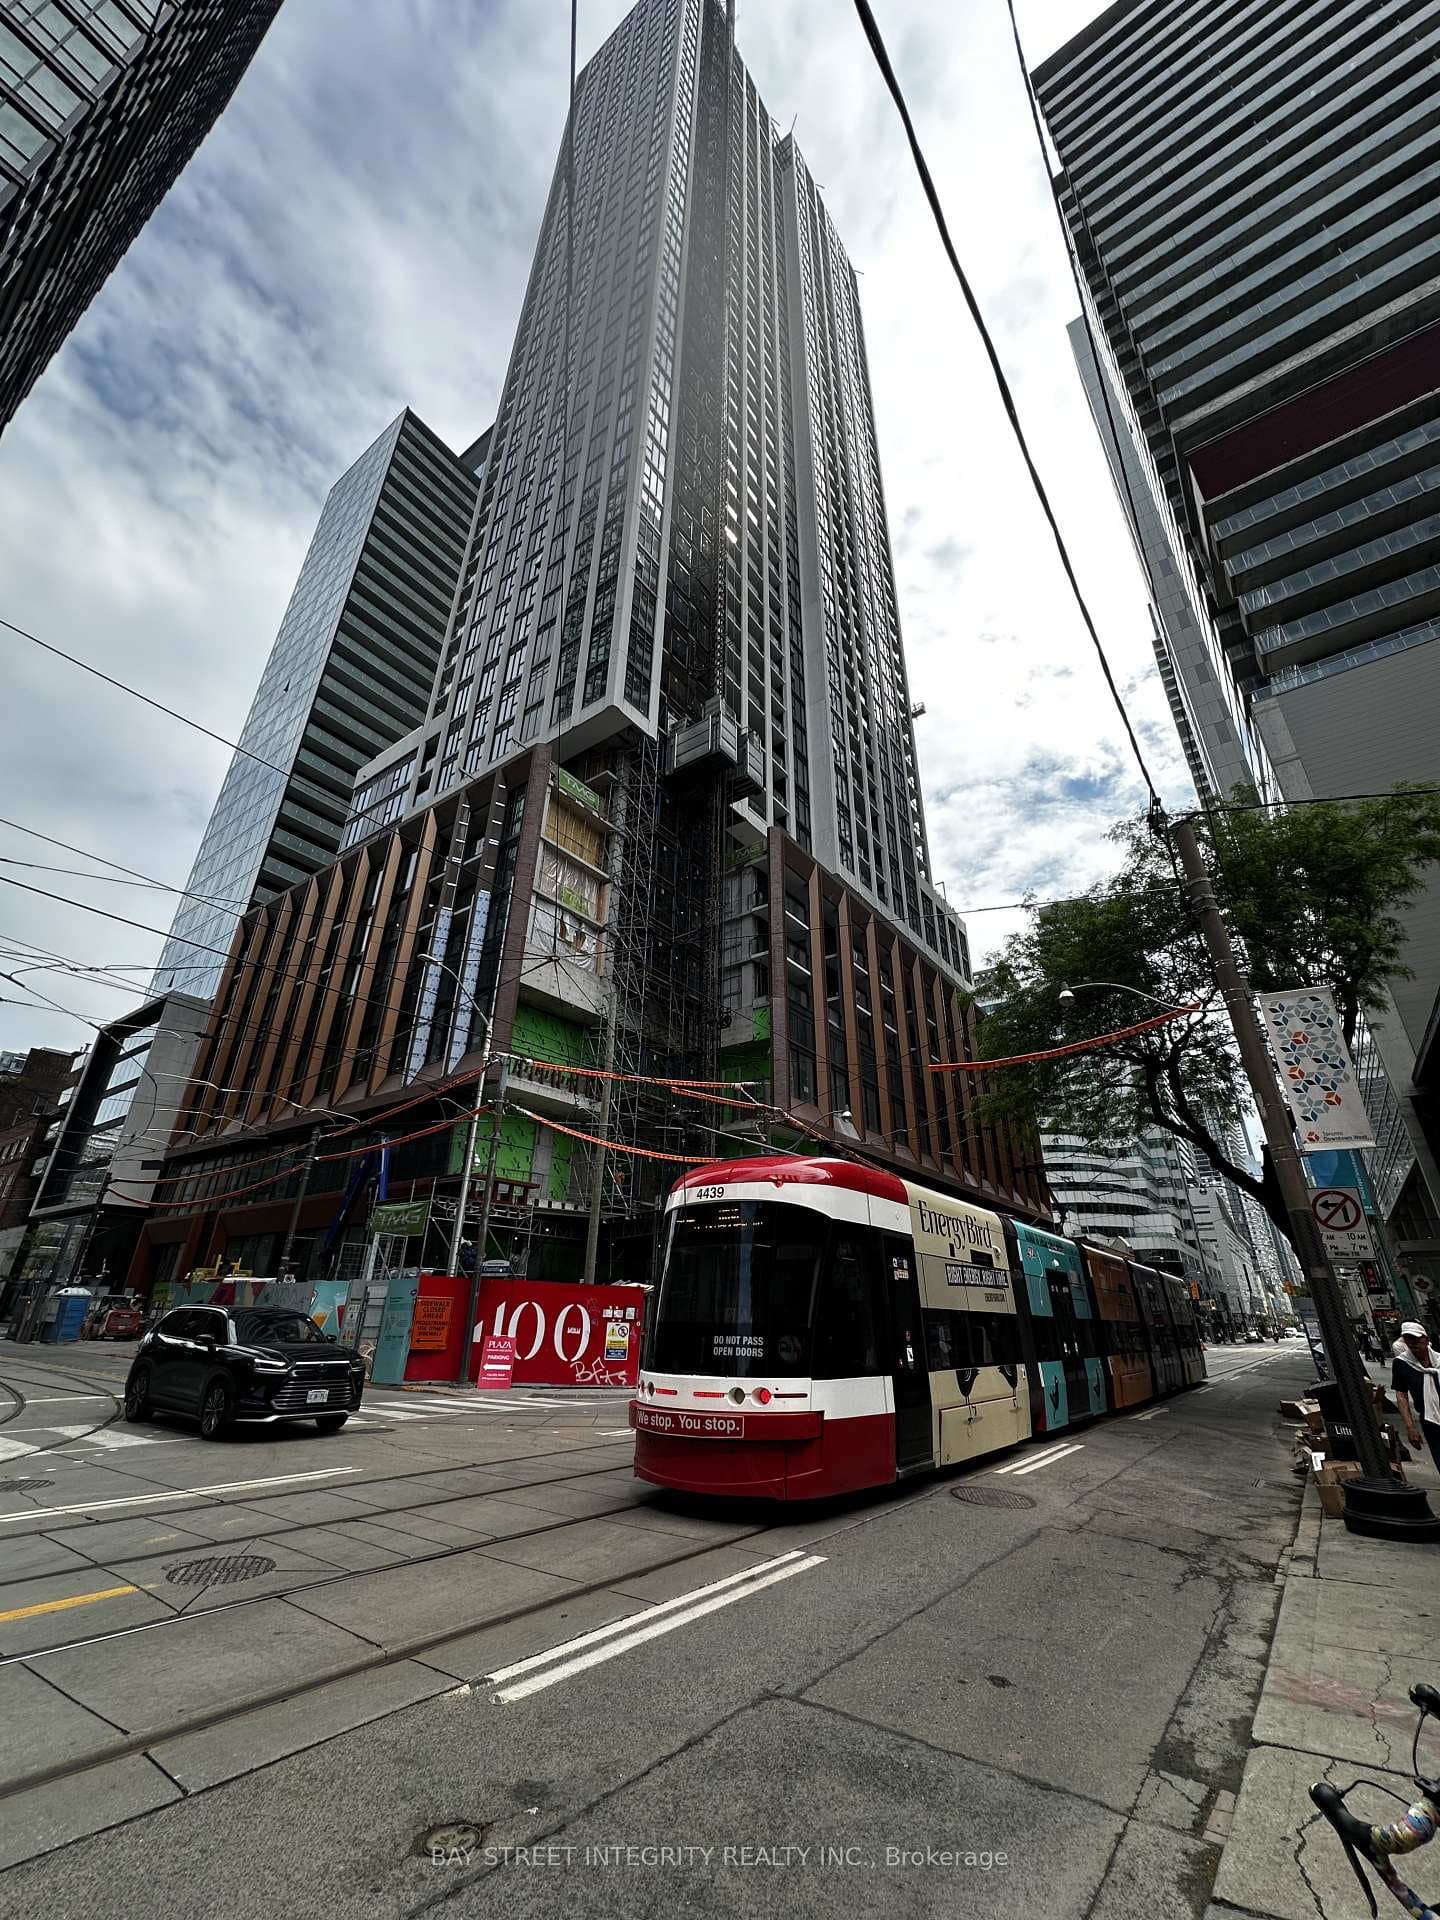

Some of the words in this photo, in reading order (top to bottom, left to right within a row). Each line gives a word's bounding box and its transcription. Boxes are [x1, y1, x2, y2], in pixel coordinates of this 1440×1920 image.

[697, 1186, 724, 1200] 4439
[918, 1199, 992, 1250] EnergyBird
[1346, 1232, 1356, 1241] 10
[1351, 1243, 1356, 1251] 7
[946, 1264, 963, 1285] RIGHT
[488, 1340, 512, 1349] PLAZA
[713, 1335, 724, 1345] DO
[725, 1335, 741, 1345] NOT
[742, 1336, 764, 1346] PASS
[713, 1346, 733, 1357] OPEN
[735, 1347, 764, 1358] DOORS
[650, 1414, 675, 1431] stop.
[679, 1415, 701, 1430] You
[705, 1417, 740, 1434] stop.
